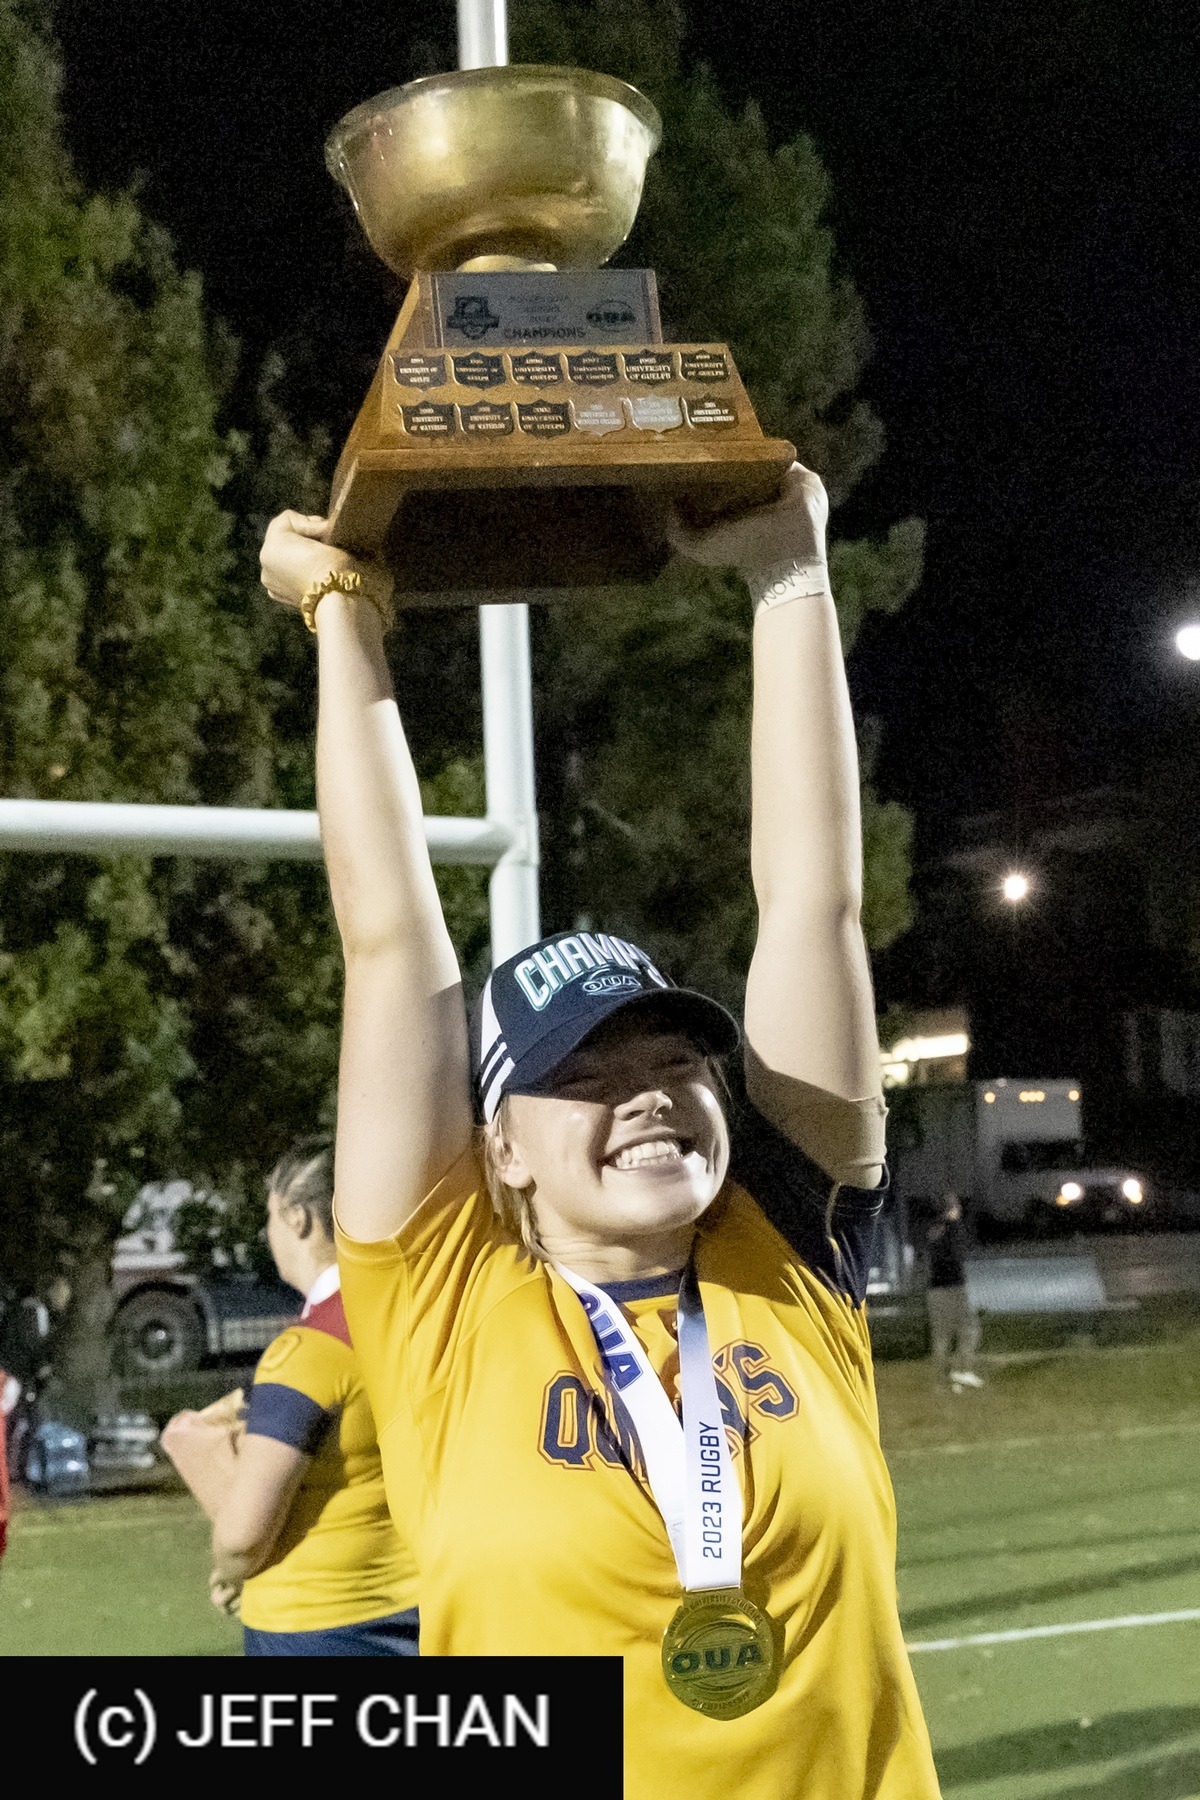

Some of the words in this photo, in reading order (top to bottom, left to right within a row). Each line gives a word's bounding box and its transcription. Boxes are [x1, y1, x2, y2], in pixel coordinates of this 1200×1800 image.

[504, 327, 587, 340] CHAMPIONS
[641, 372, 671, 380] GUELPH
[699, 1421, 721, 1493] RUGBY
[702, 1501, 722, 1559] 2023
[671, 1642, 763, 1675] OUA
